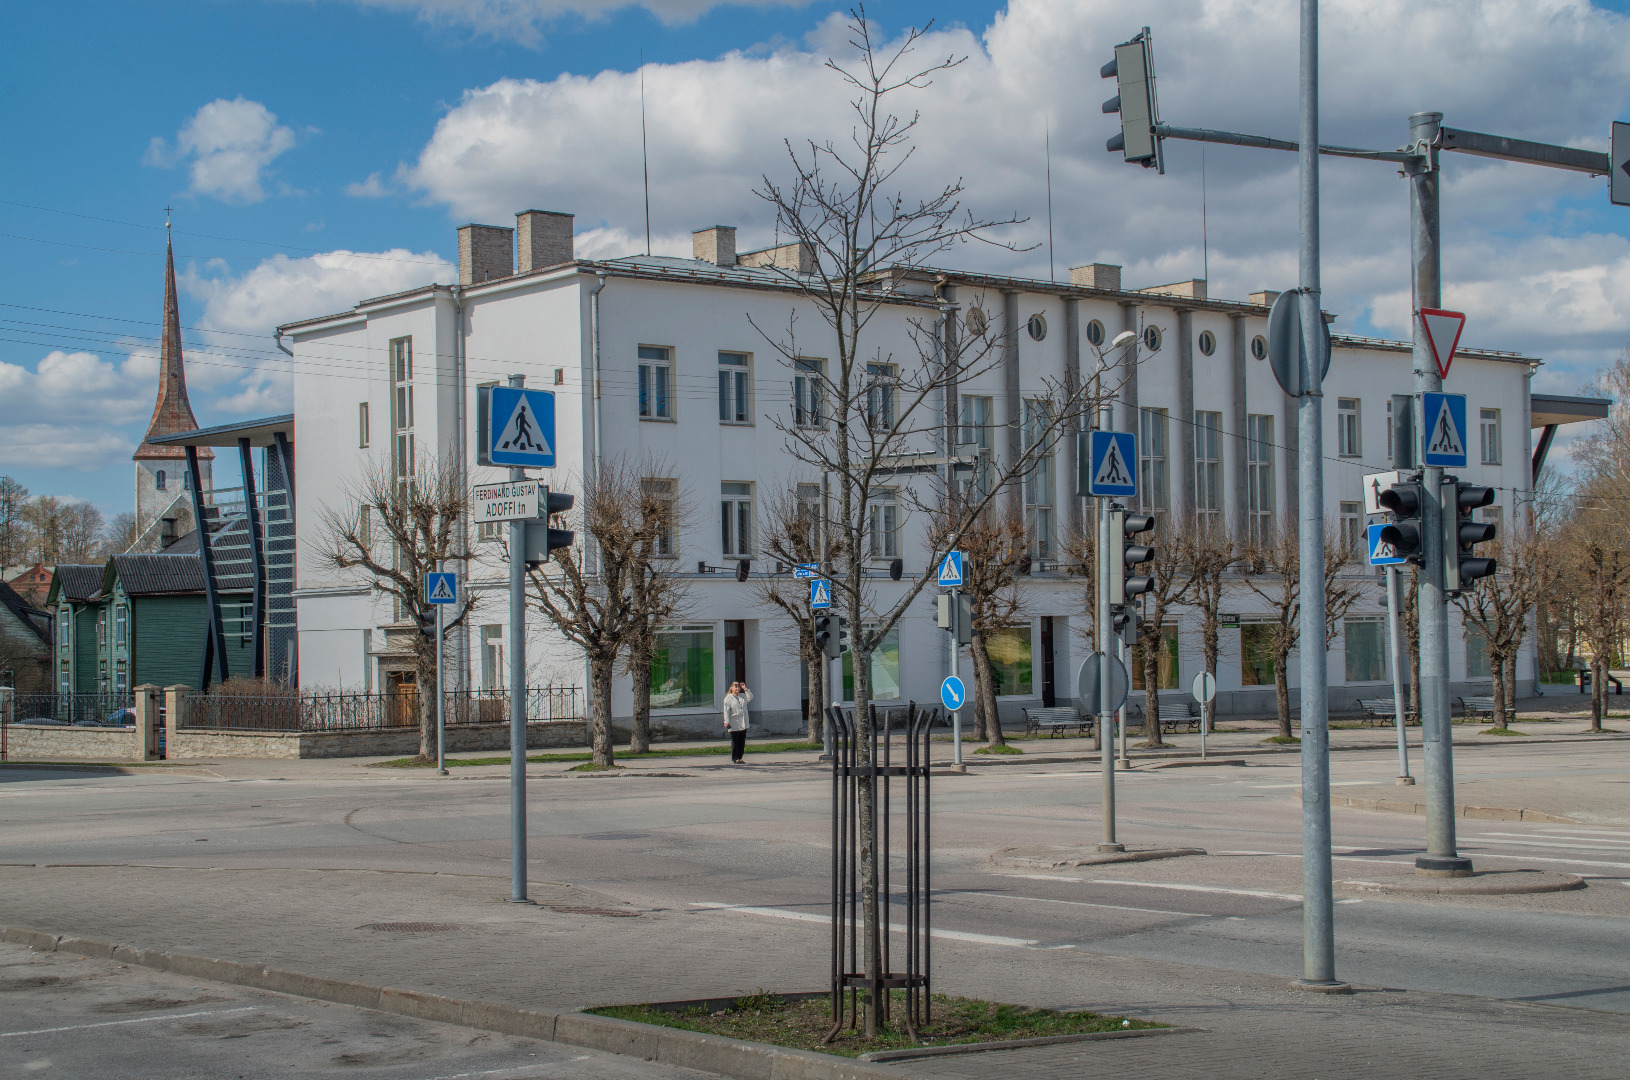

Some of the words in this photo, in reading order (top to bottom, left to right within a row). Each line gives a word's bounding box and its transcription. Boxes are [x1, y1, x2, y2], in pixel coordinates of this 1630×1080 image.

[475, 487, 510, 501] FERDINAND
[511, 485, 536, 498] GUSTAV
[486, 501, 516, 517] ADOFFI
[518, 502, 526, 515] tn
